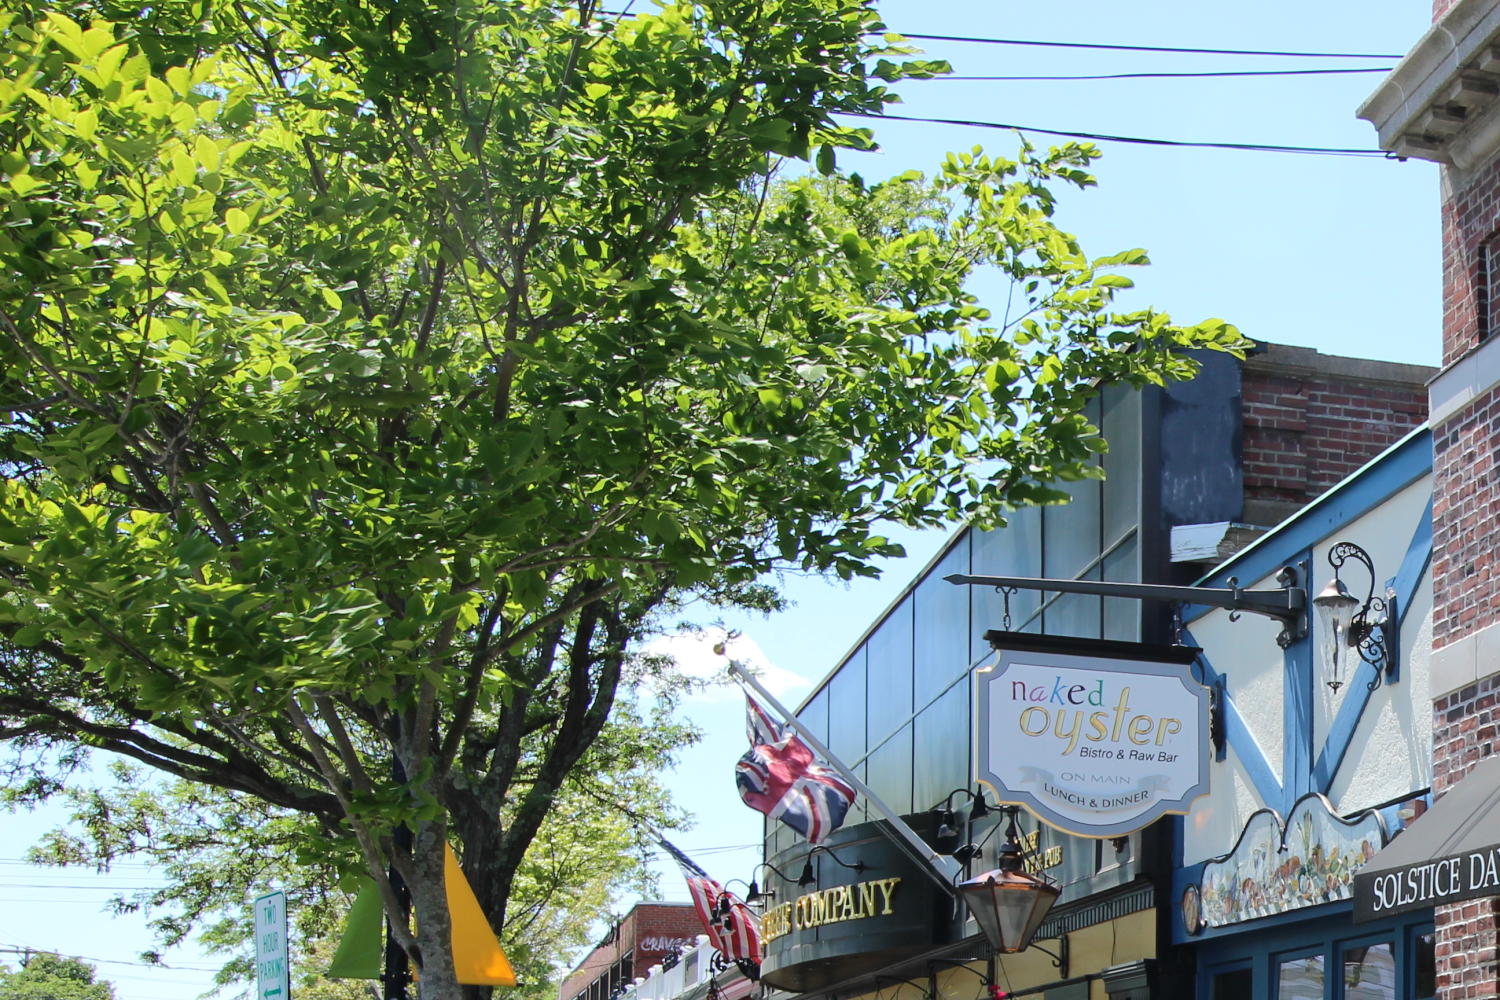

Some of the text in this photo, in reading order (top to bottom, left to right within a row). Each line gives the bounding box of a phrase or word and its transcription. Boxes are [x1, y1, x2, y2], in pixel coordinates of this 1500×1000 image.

[1012, 676, 1104, 707] naked
[1019, 686, 1183, 756] oyster
[1079, 746, 1179, 763] Bistro & Raw Bar
[1060, 771, 1131, 785] ON MAIN
[1043, 783, 1149, 808] LUNCH & DINNER
[1373, 857, 1461, 912] SOLSTICE
[264, 904, 277, 926] TWO
[795, 877, 902, 931] COMPANY
[263, 931, 279, 953] HOUR
